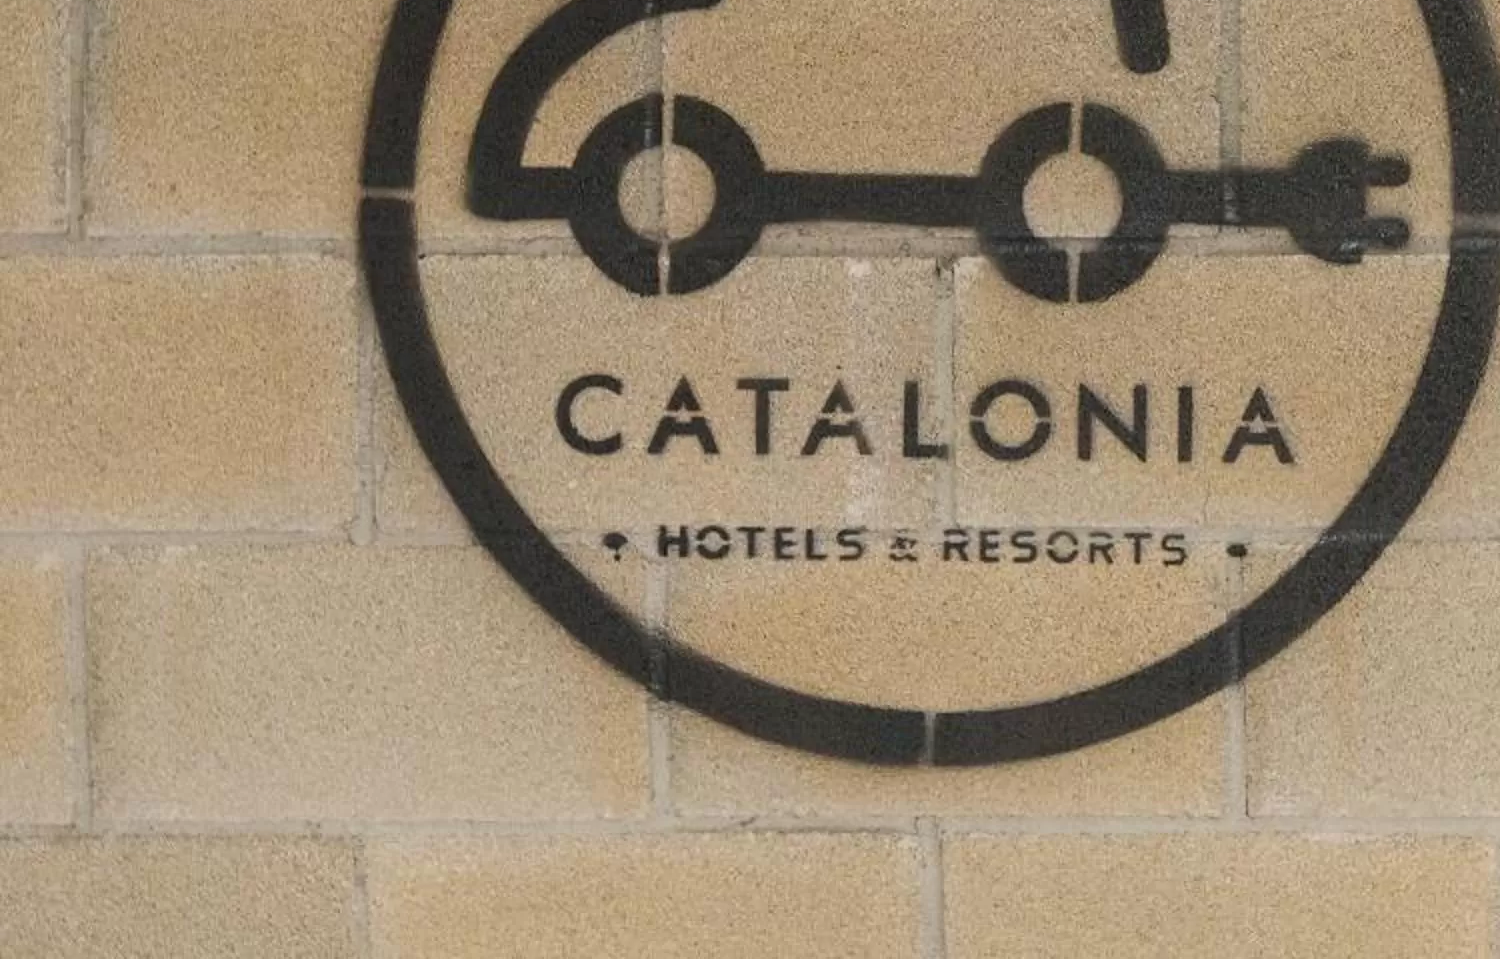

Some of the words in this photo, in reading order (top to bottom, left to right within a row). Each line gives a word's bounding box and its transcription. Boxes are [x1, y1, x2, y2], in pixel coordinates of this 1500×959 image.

[555, 374, 1296, 463] CATALONIA
[658, 524, 867, 561] HOTELS
[942, 527, 1190, 566] RESORTS
